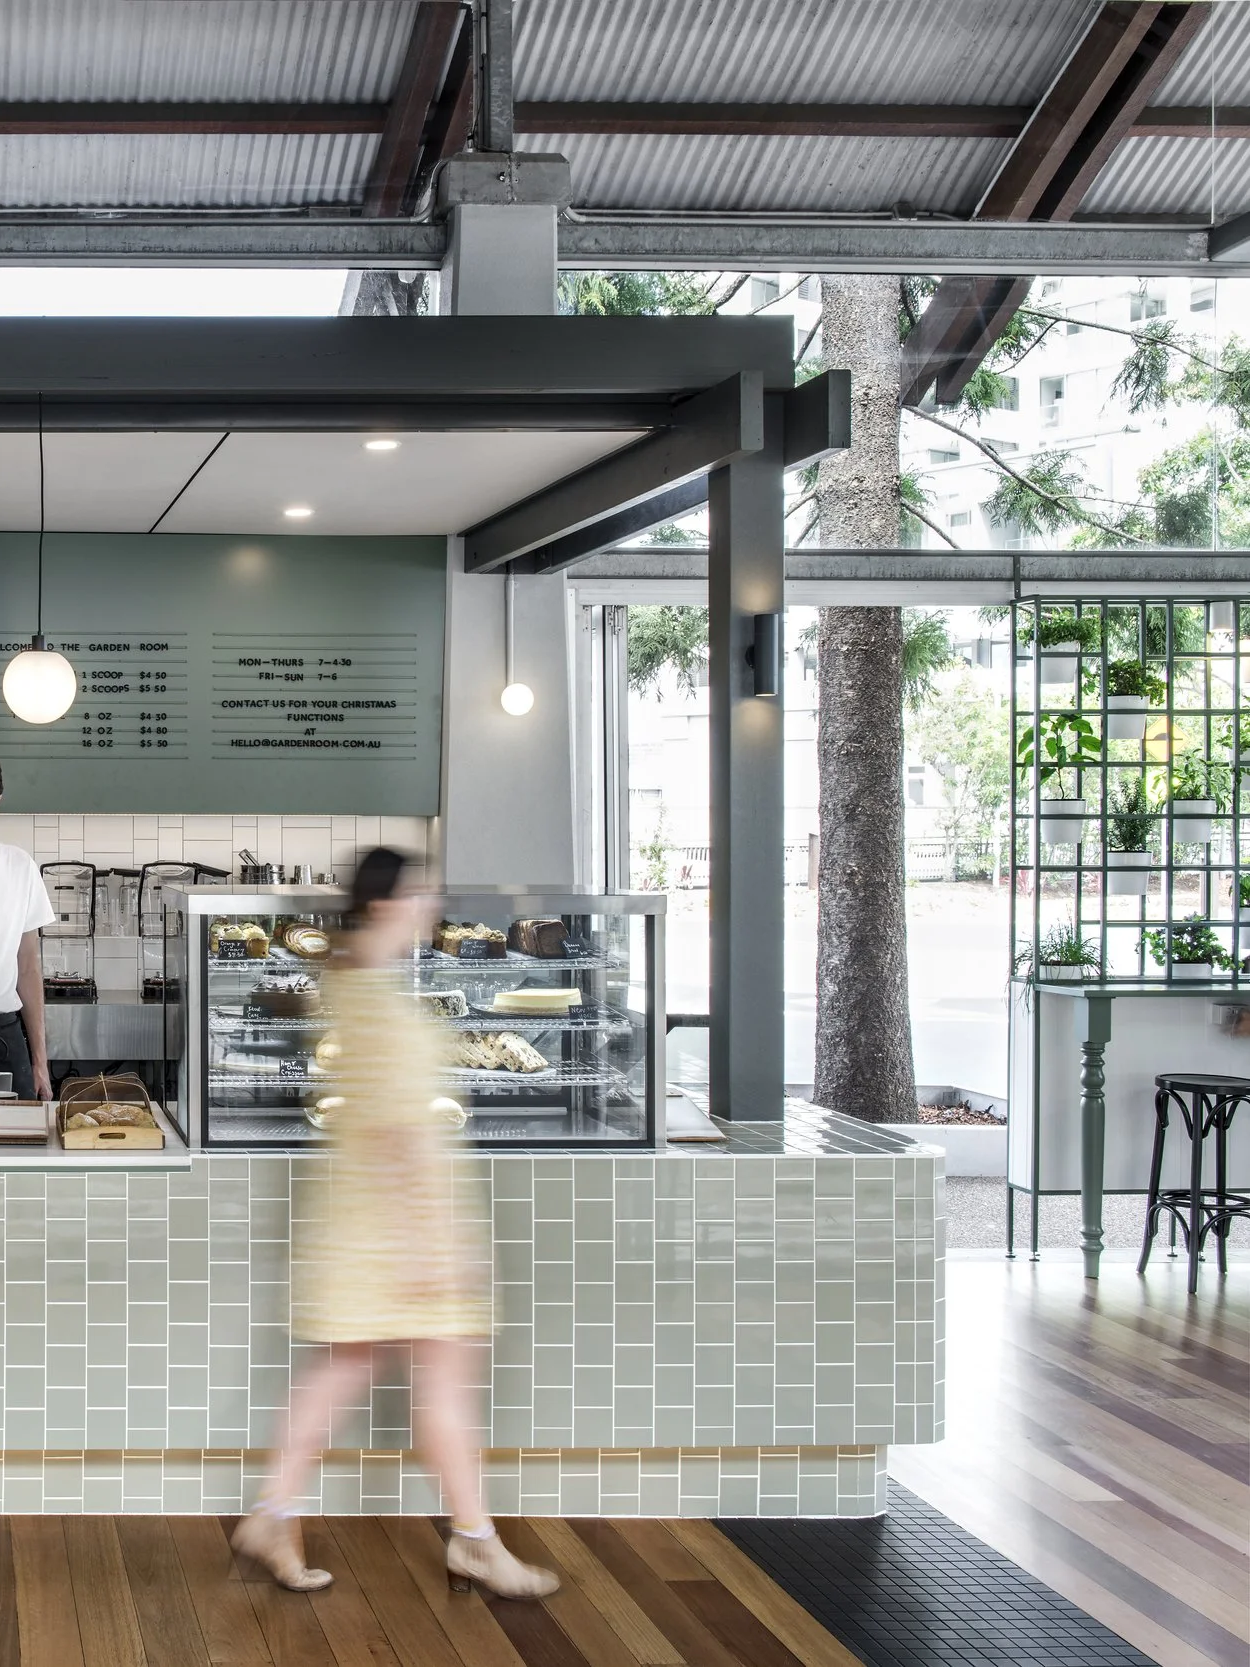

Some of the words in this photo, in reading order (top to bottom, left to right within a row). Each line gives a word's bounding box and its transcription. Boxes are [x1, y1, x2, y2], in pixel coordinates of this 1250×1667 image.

[91, 671, 123, 679] SCOOP
[140, 671, 151, 680] $4
[91, 684, 129, 693] SCOOPS
[139, 685, 150, 693] $5
[221, 700, 269, 708] CONTACT
[341, 700, 396, 708] CHRISTMAS
[140, 712, 151, 720] $4
[140, 726, 151, 734] $4
